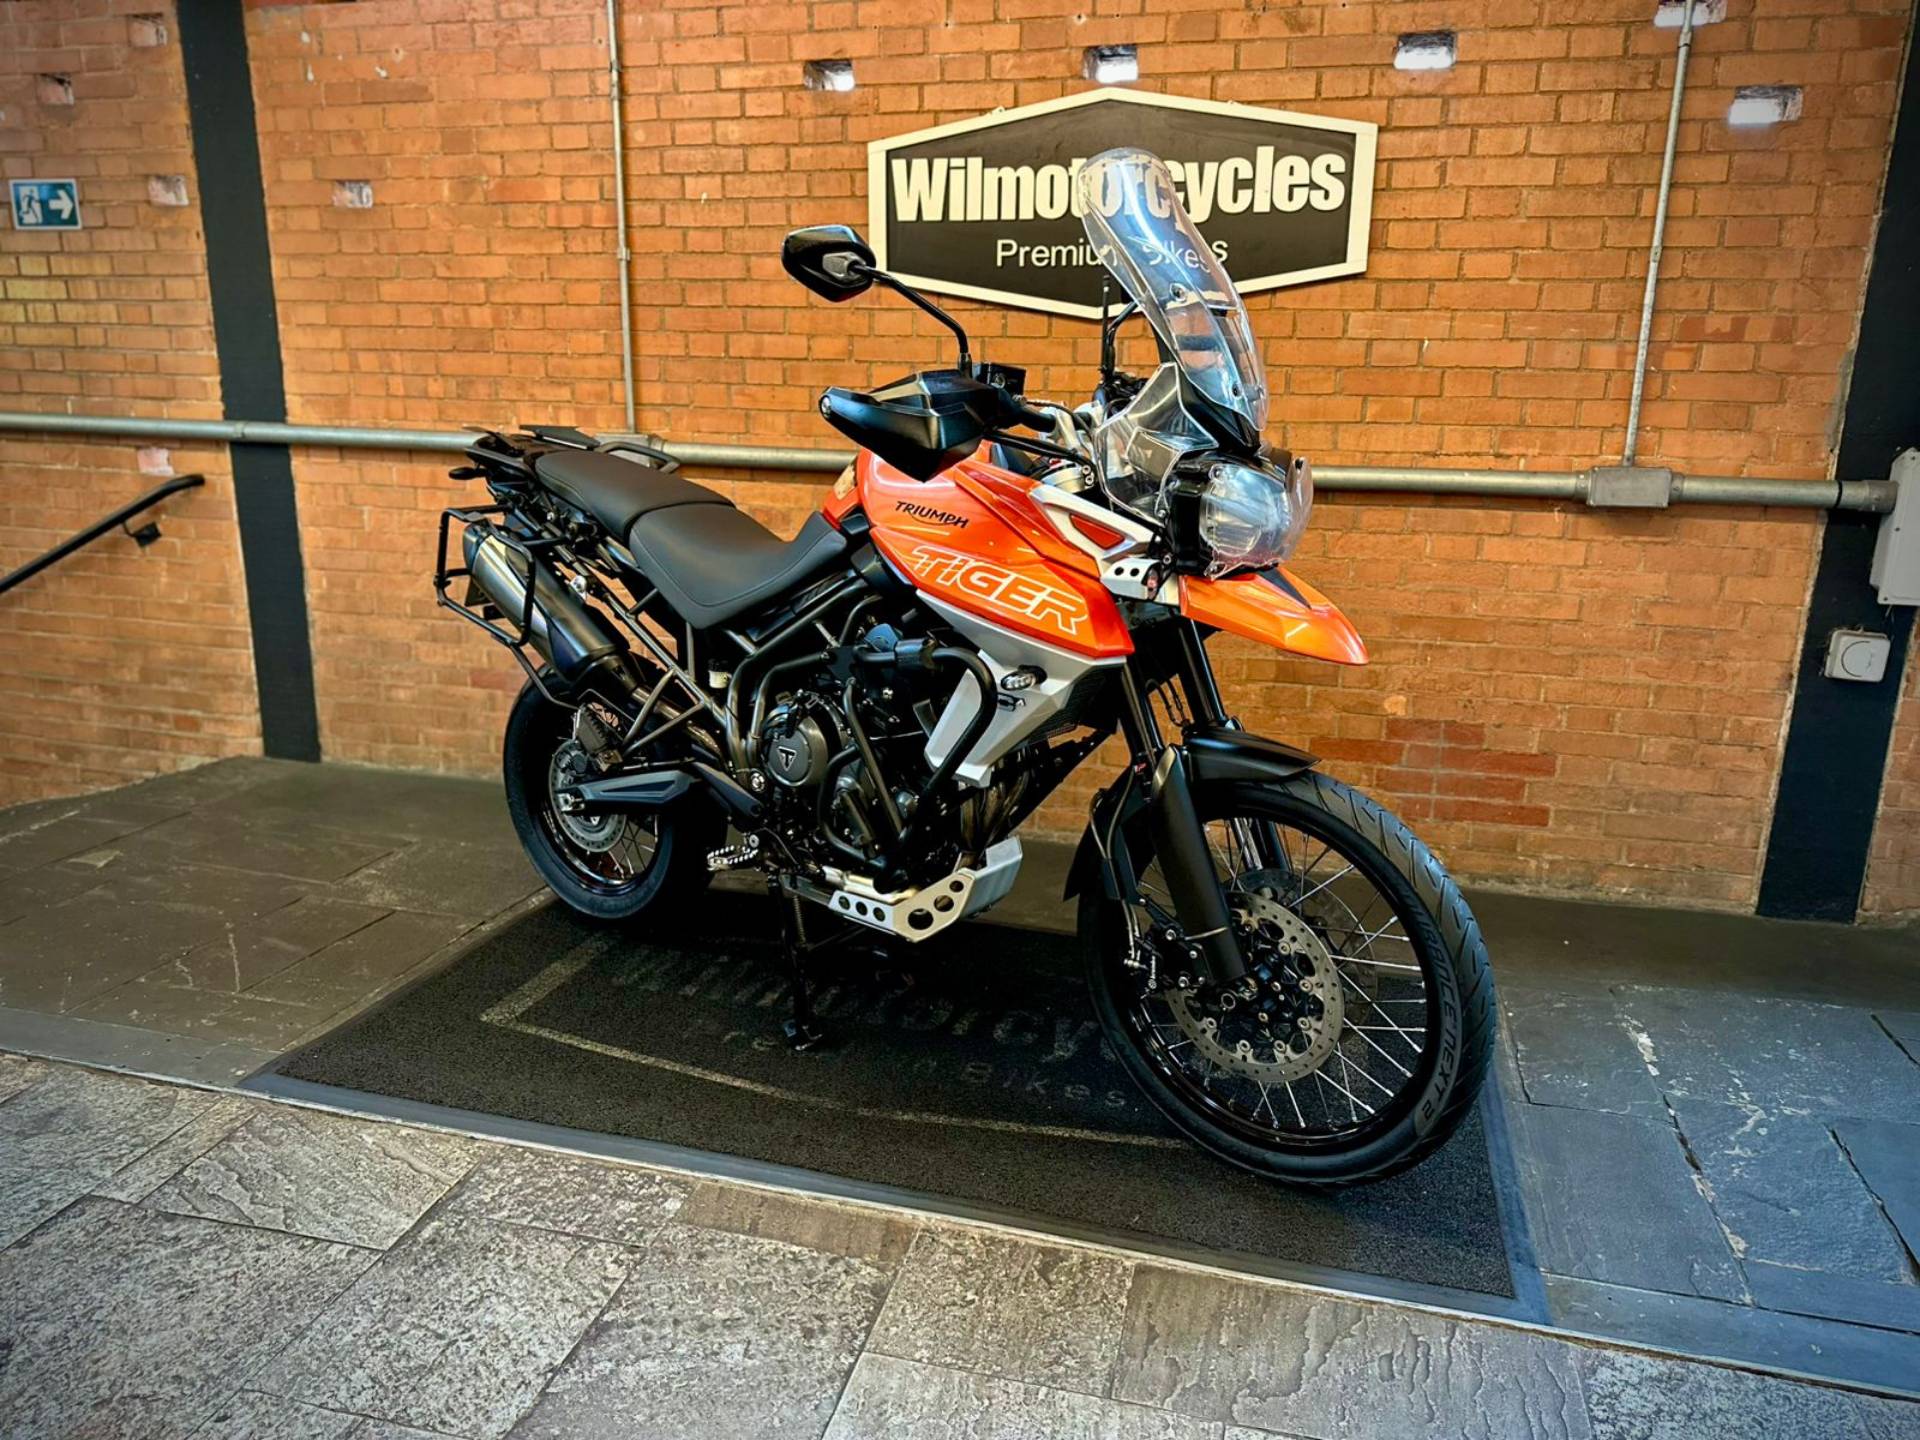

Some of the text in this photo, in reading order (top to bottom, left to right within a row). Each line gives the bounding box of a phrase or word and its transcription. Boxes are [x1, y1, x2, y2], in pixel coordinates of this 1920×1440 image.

[891, 145, 1346, 223] Wilmotorcycles
[895, 500, 970, 529] TRIUMPH
[911, 545, 1089, 635] TIGER
[1434, 1027, 1457, 1102] NEXT
